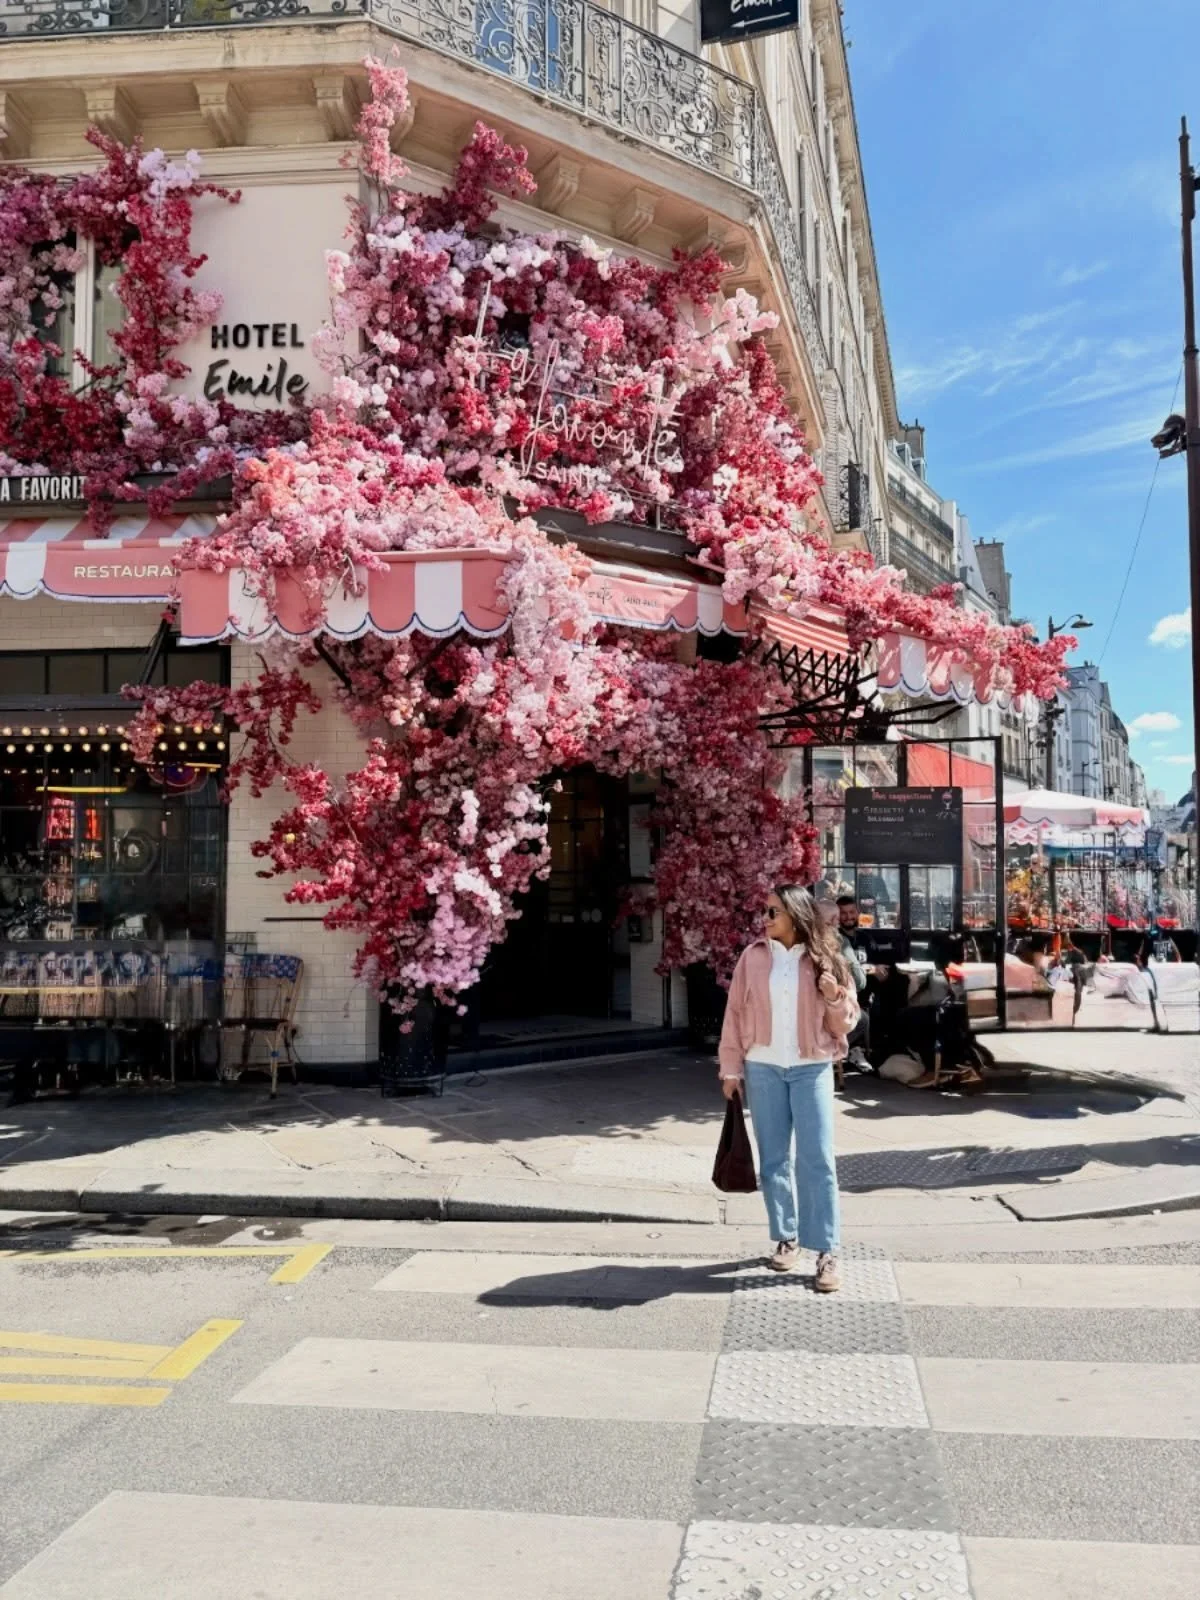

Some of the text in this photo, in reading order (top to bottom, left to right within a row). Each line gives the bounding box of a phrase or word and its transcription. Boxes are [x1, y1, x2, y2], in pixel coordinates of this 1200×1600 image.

[211, 323, 304, 349] HOTEL
[203, 357, 309, 403] Emile
[535, 462, 593, 488] SAINT
[74, 565, 178, 578] RESTAURA
